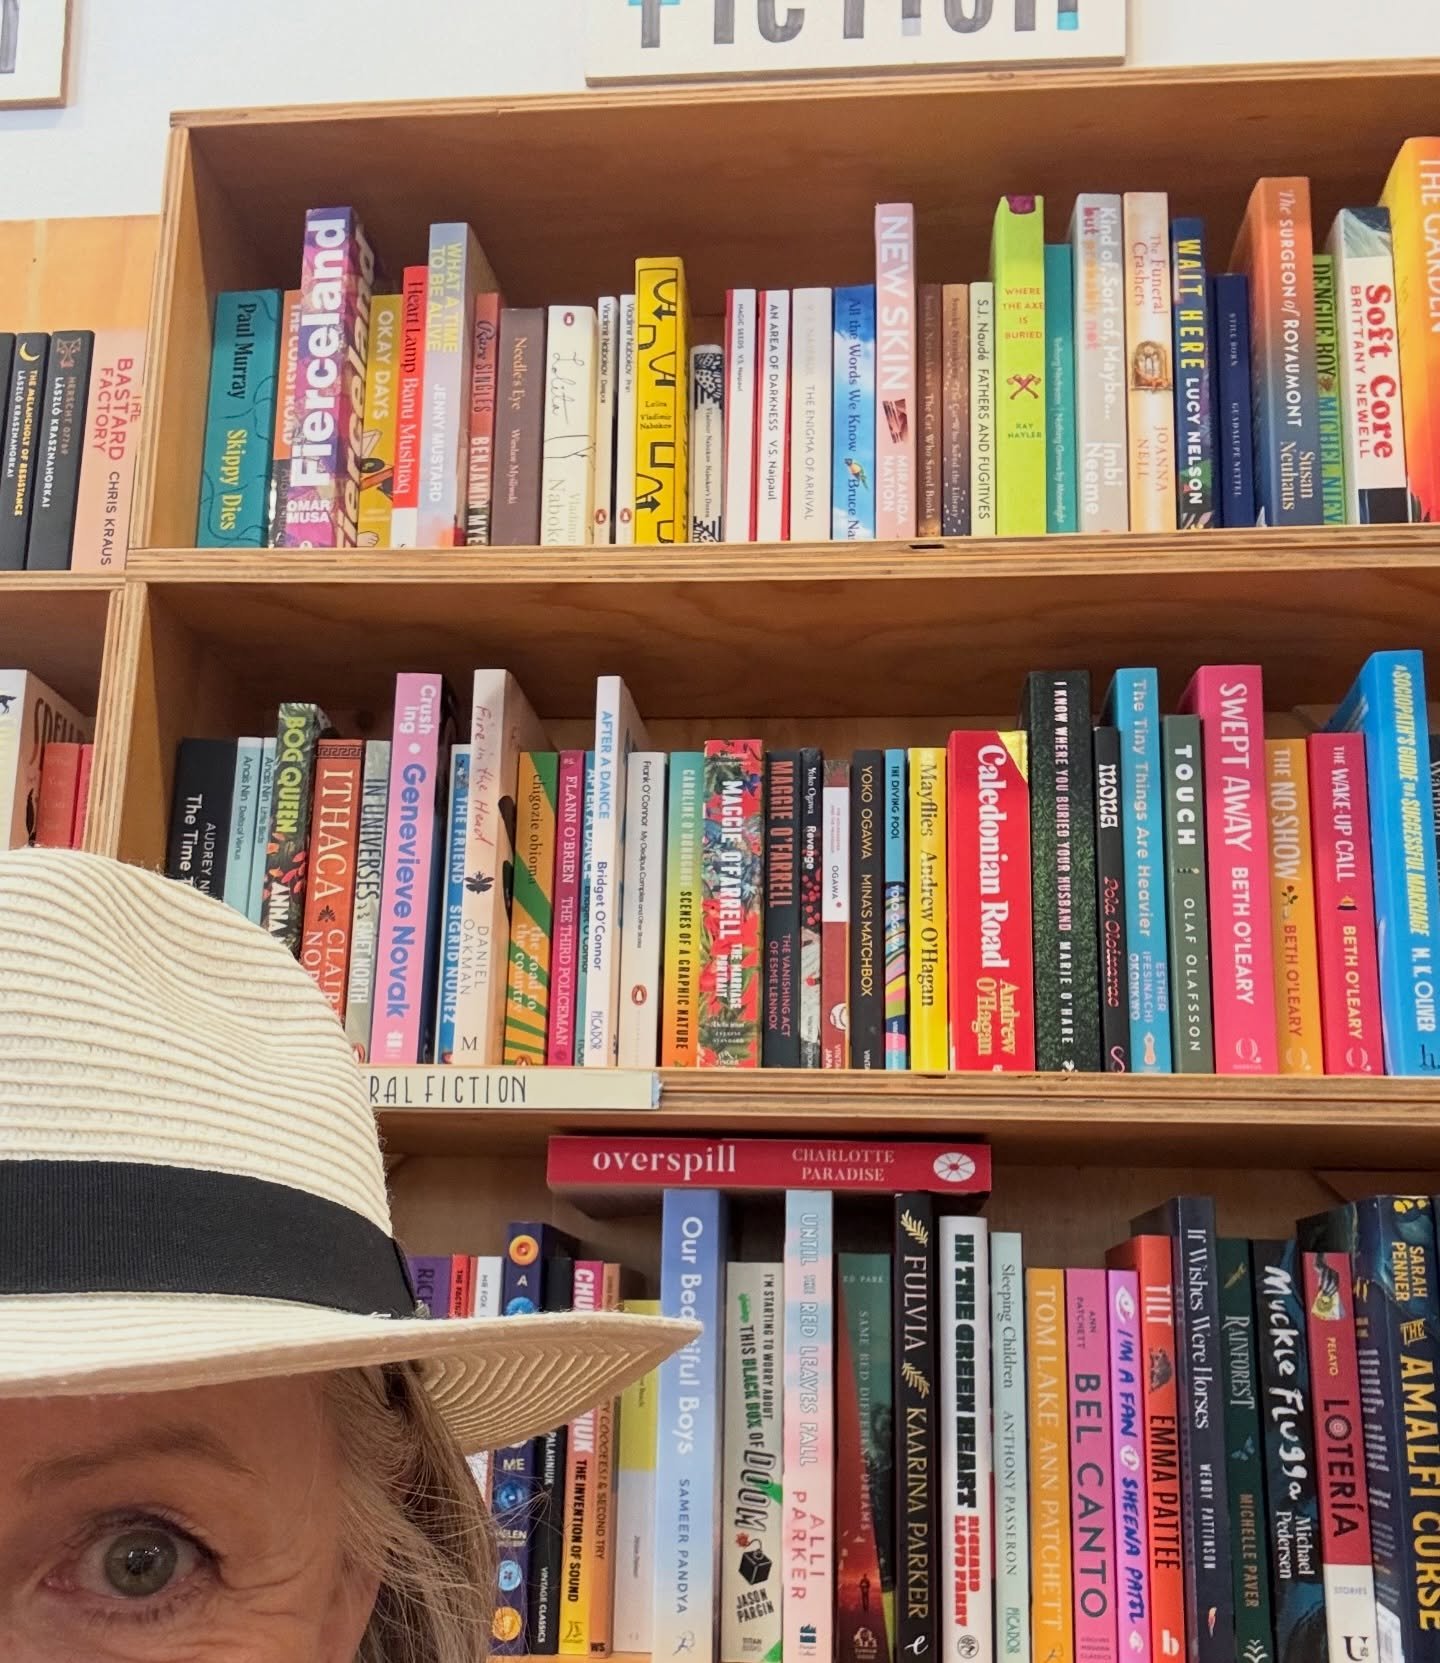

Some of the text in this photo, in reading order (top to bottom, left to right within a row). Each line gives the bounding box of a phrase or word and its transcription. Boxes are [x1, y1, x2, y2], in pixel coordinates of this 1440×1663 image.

[227, 304, 256, 399] Paul Murray
[290, 219, 347, 486] Fierceland
[400, 282, 424, 373] Heart Lamp
[880, 215, 909, 389] NEW SKIN
[978, 300, 989, 360] S.J. Naudé
[1178, 240, 1205, 369] WAIT HERE
[1279, 190, 1301, 427] The SURGEON of ROYAUMONT
[93, 368, 113, 453] FACTORY
[109, 358, 133, 460] BASTARD
[373, 311, 393, 419] OKAY DAYS
[551, 352, 584, 424] Lolita
[768, 304, 779, 431] AN AREA OF DARKNESS
[847, 298, 861, 452] All the Words We Know
[1350, 285, 1370, 459] BRITTANY NEWELL
[1365, 284, 1396, 459] Soft Core
[14, 370, 37, 516] THE MELANCHOLY OF RESISTANCE
[42, 377, 66, 507] LÁSZLÓ KRASZNAHORKAI
[220, 428, 247, 530] Skippy Dies
[395, 377, 418, 494] Banu Mushtaq
[429, 383, 448, 501] JENNY MUSTARD
[767, 440, 777, 500] V.S. Naipaul
[978, 368, 990, 519] FATHERS AND FUGITIVES
[1186, 377, 1202, 504] LUCY NELSON
[1280, 441, 1296, 510] Neuhaus
[1299, 451, 1316, 499] Susan
[101, 472, 120, 565] CHRIS KRAUS
[847, 479, 859, 515] Bruce
[275, 716, 304, 832] BOG QUEEN
[1132, 680, 1153, 937] The Tiny Things Are Heavier
[1219, 683, 1252, 852] SWEPT AWAY
[180, 794, 202, 870] The Time
[200, 823, 216, 876] AUDREY
[314, 769, 353, 902] ITHACA
[562, 775, 579, 883] FLANN O'BRIEN
[769, 761, 794, 908] MAGGIE O'FARRELL
[861, 766, 873, 996] YOKO OGAWA MINA'S MATCHBOX
[917, 763, 938, 1007] Mayflies Andrew O'Hagan
[978, 745, 1009, 969] Caledonian Road
[387, 764, 427, 1018] Genevieve Novak
[592, 862, 608, 971] Bridget O'Connor
[679, 891, 693, 930] SCENES
[679, 933, 691, 946] OF
[1175, 745, 1200, 1052] TOUCH OLAF OLAFSSON
[1231, 867, 1254, 1004] BETH O'LEARY
[459, 920, 474, 995] OAKMAN
[474, 926, 489, 987] DANIEL
[555, 897, 573, 1045] THE THIRD POLICEMAN
[677, 960, 691, 1005] GRAPHIC
[768, 941, 780, 1030] OF ESME LENNOX
[781, 934, 792, 1036] THE VANISHING ACT
[675, 1010, 690, 1049] NATURE
[426, 1075, 526, 1103] FICTION
[592, 1145, 737, 1181] overspill
[792, 1148, 895, 1164] CHARLOTTE
[801, 1166, 885, 1181] PARADISE
[904, 1255, 927, 1351] FULVIA
[996, 1264, 1017, 1389] Sleeping Children
[1188, 1228, 1211, 1428] If Wishes Were Horses
[1392, 1242, 1411, 1301] PENNER
[1409, 1246, 1427, 1298] SARAH
[955, 1234, 976, 1508] IN THE GREEN HEART
[1223, 1315, 1255, 1409] RAINFOREST
[1035, 1286, 1062, 1631] TOM LAKE ANN PATCHETT
[1146, 1284, 1179, 1570] TILT EMMA PATTEE
[1323, 1400, 1359, 1536] LOTERÍA
[568, 1460, 587, 1602] THE INVENTION OF SOUND
[676, 1479, 691, 1614] SAMEER PANDYA
[907, 1407, 928, 1618] KAARINA PARKER
[1003, 1410, 1017, 1575] ANTHONY PASSERON
[1075, 1373, 1107, 1618] BEL CANTO
[1241, 1494, 1259, 1607] MICHELLE PAVER
[1276, 1511, 1294, 1579] Pedersen
[1295, 1516, 1314, 1575] Michael
